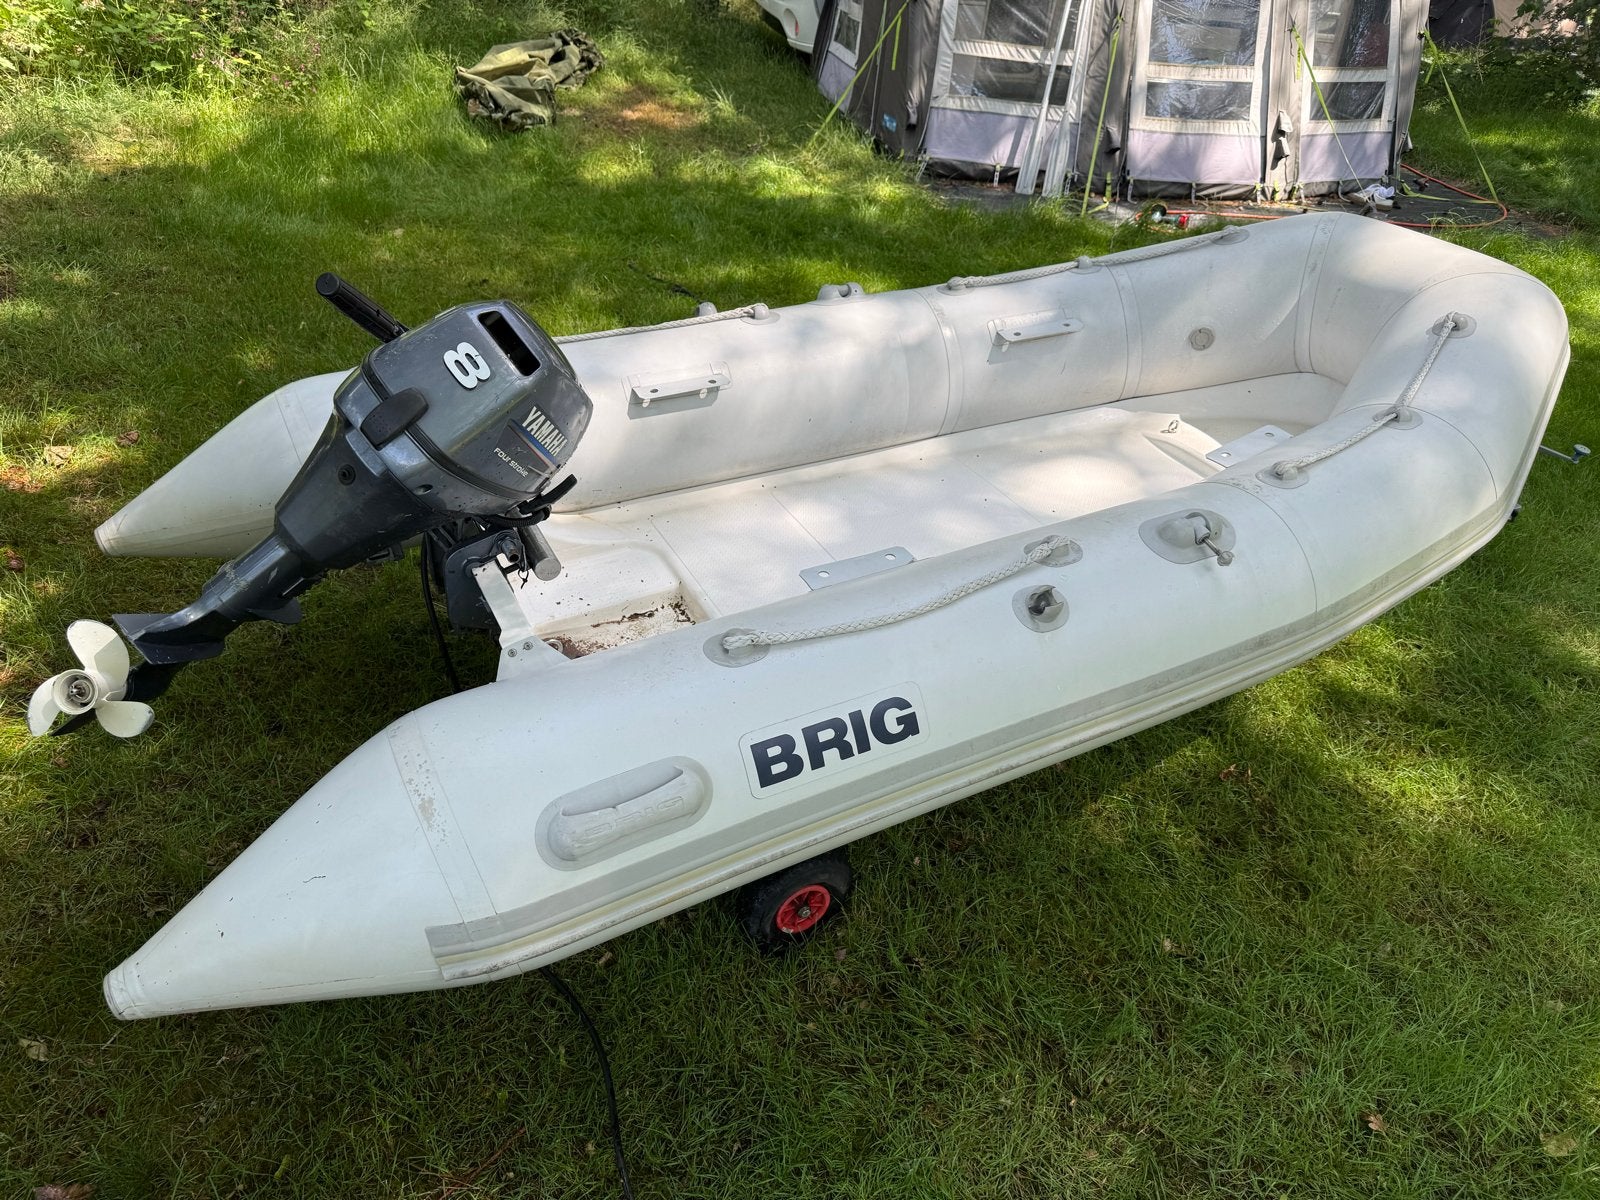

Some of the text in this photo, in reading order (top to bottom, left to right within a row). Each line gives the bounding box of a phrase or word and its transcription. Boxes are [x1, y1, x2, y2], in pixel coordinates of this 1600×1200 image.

[442, 341, 491, 391] 8
[522, 405, 568, 457] YAMAHA
[750, 696, 920, 789] BRIG
